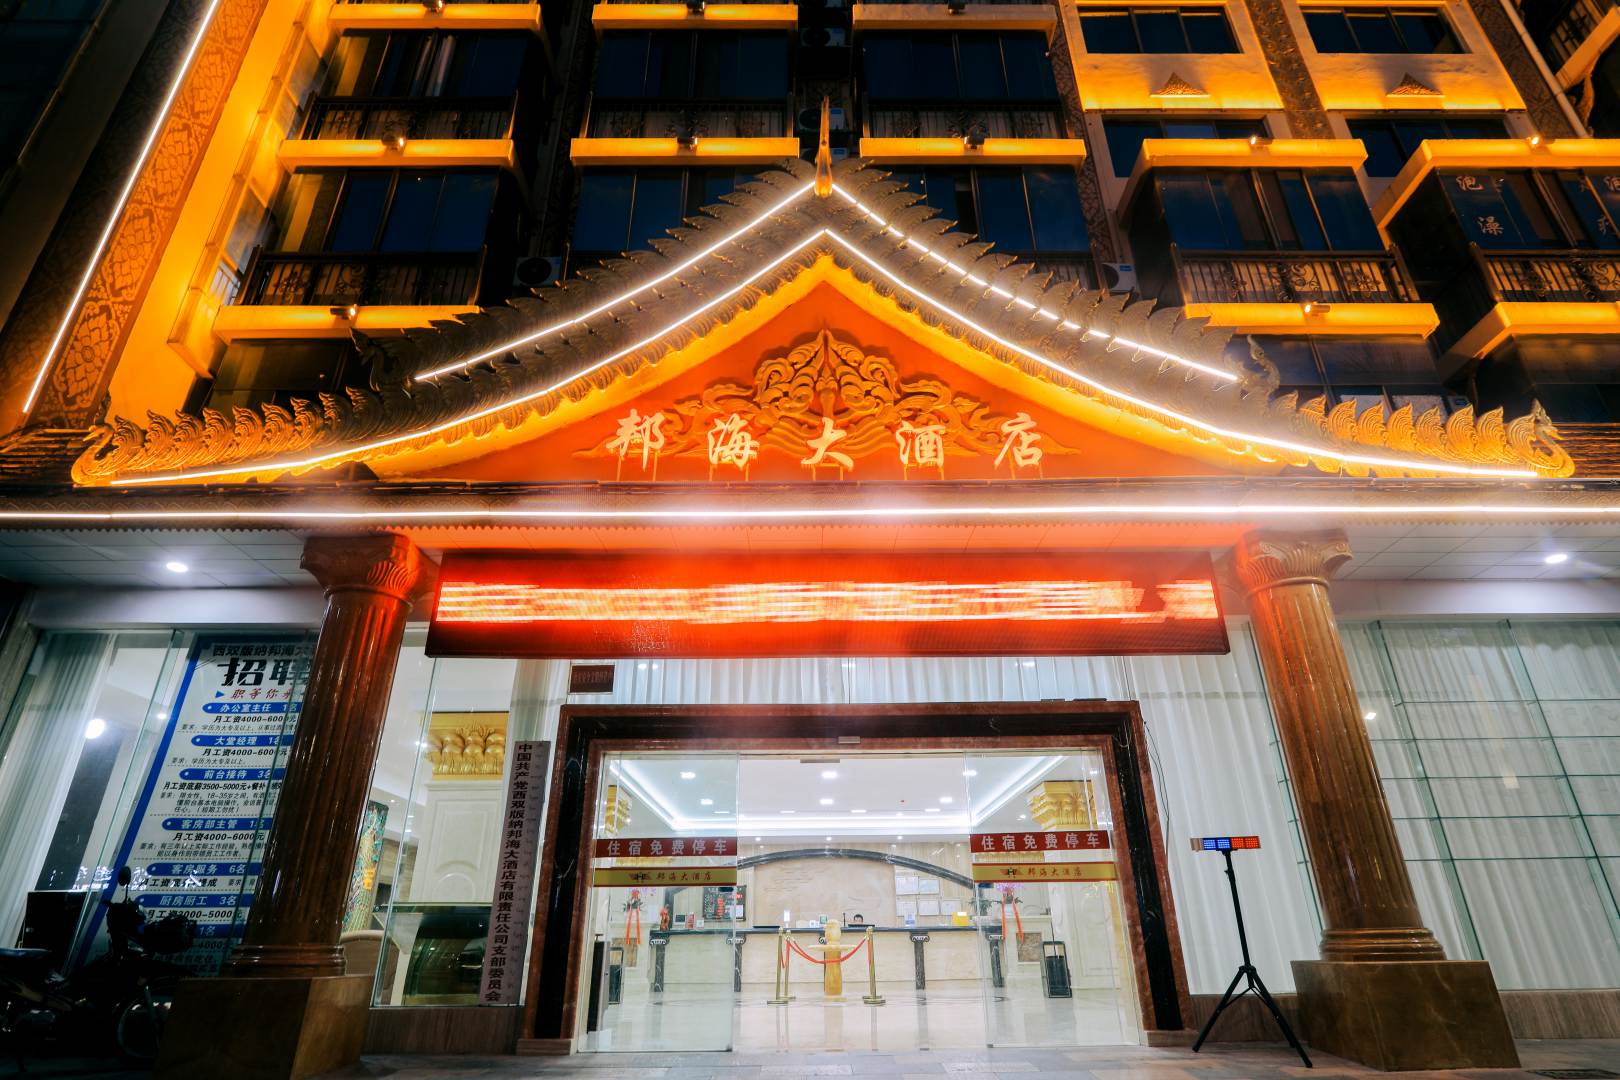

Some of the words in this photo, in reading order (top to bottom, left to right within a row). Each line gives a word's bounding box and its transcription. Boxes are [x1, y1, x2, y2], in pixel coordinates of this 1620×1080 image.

[605, 408, 1044, 470] 邦海大酒店
[220, 704, 271, 713] 办公室主任
[214, 736, 257, 745] 大堂经理
[202, 748, 287, 757] 月工资4000-600元
[204, 769, 247, 779] 前台接待
[181, 819, 238, 829] 客房部主管
[981, 832, 1100, 850] 住宿免费停车
[607, 839, 727, 856] 住宿免费停车
[229, 864, 246, 874] 6名
[485, 744, 532, 1002] 中国共产党西双版纳邦海大酒店有限责任公司支部委员会
[160, 895, 208, 905] 厨房厨工
[219, 895, 238, 905] 3名
